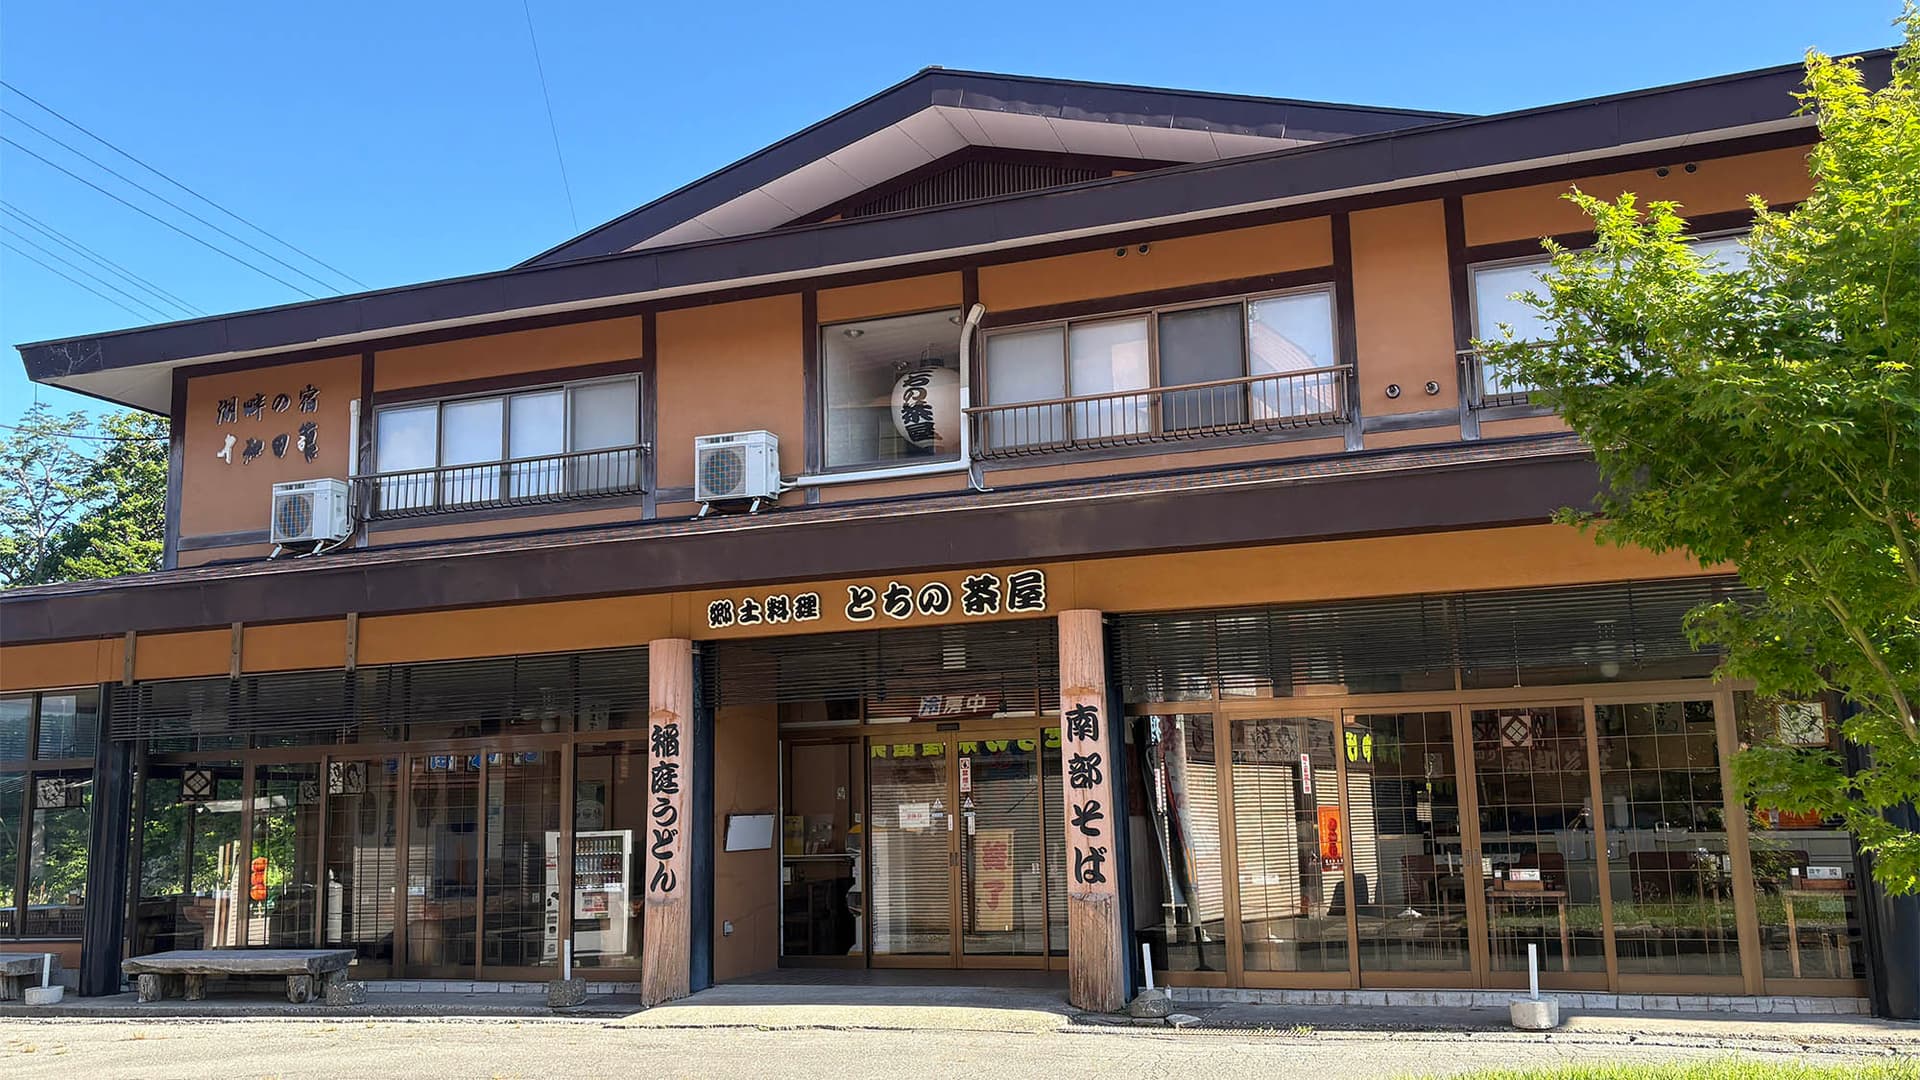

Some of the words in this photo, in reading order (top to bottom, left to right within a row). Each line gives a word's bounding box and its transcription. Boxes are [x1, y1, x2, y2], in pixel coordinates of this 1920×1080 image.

[216, 384, 321, 426] 湖畔の宿
[708, 593, 820, 628] 郷土料理
[846, 570, 1046, 622] とちの茶屋
[650, 724, 680, 893] 稲庭うどん
[1065, 703, 1107, 884] 南部そば
